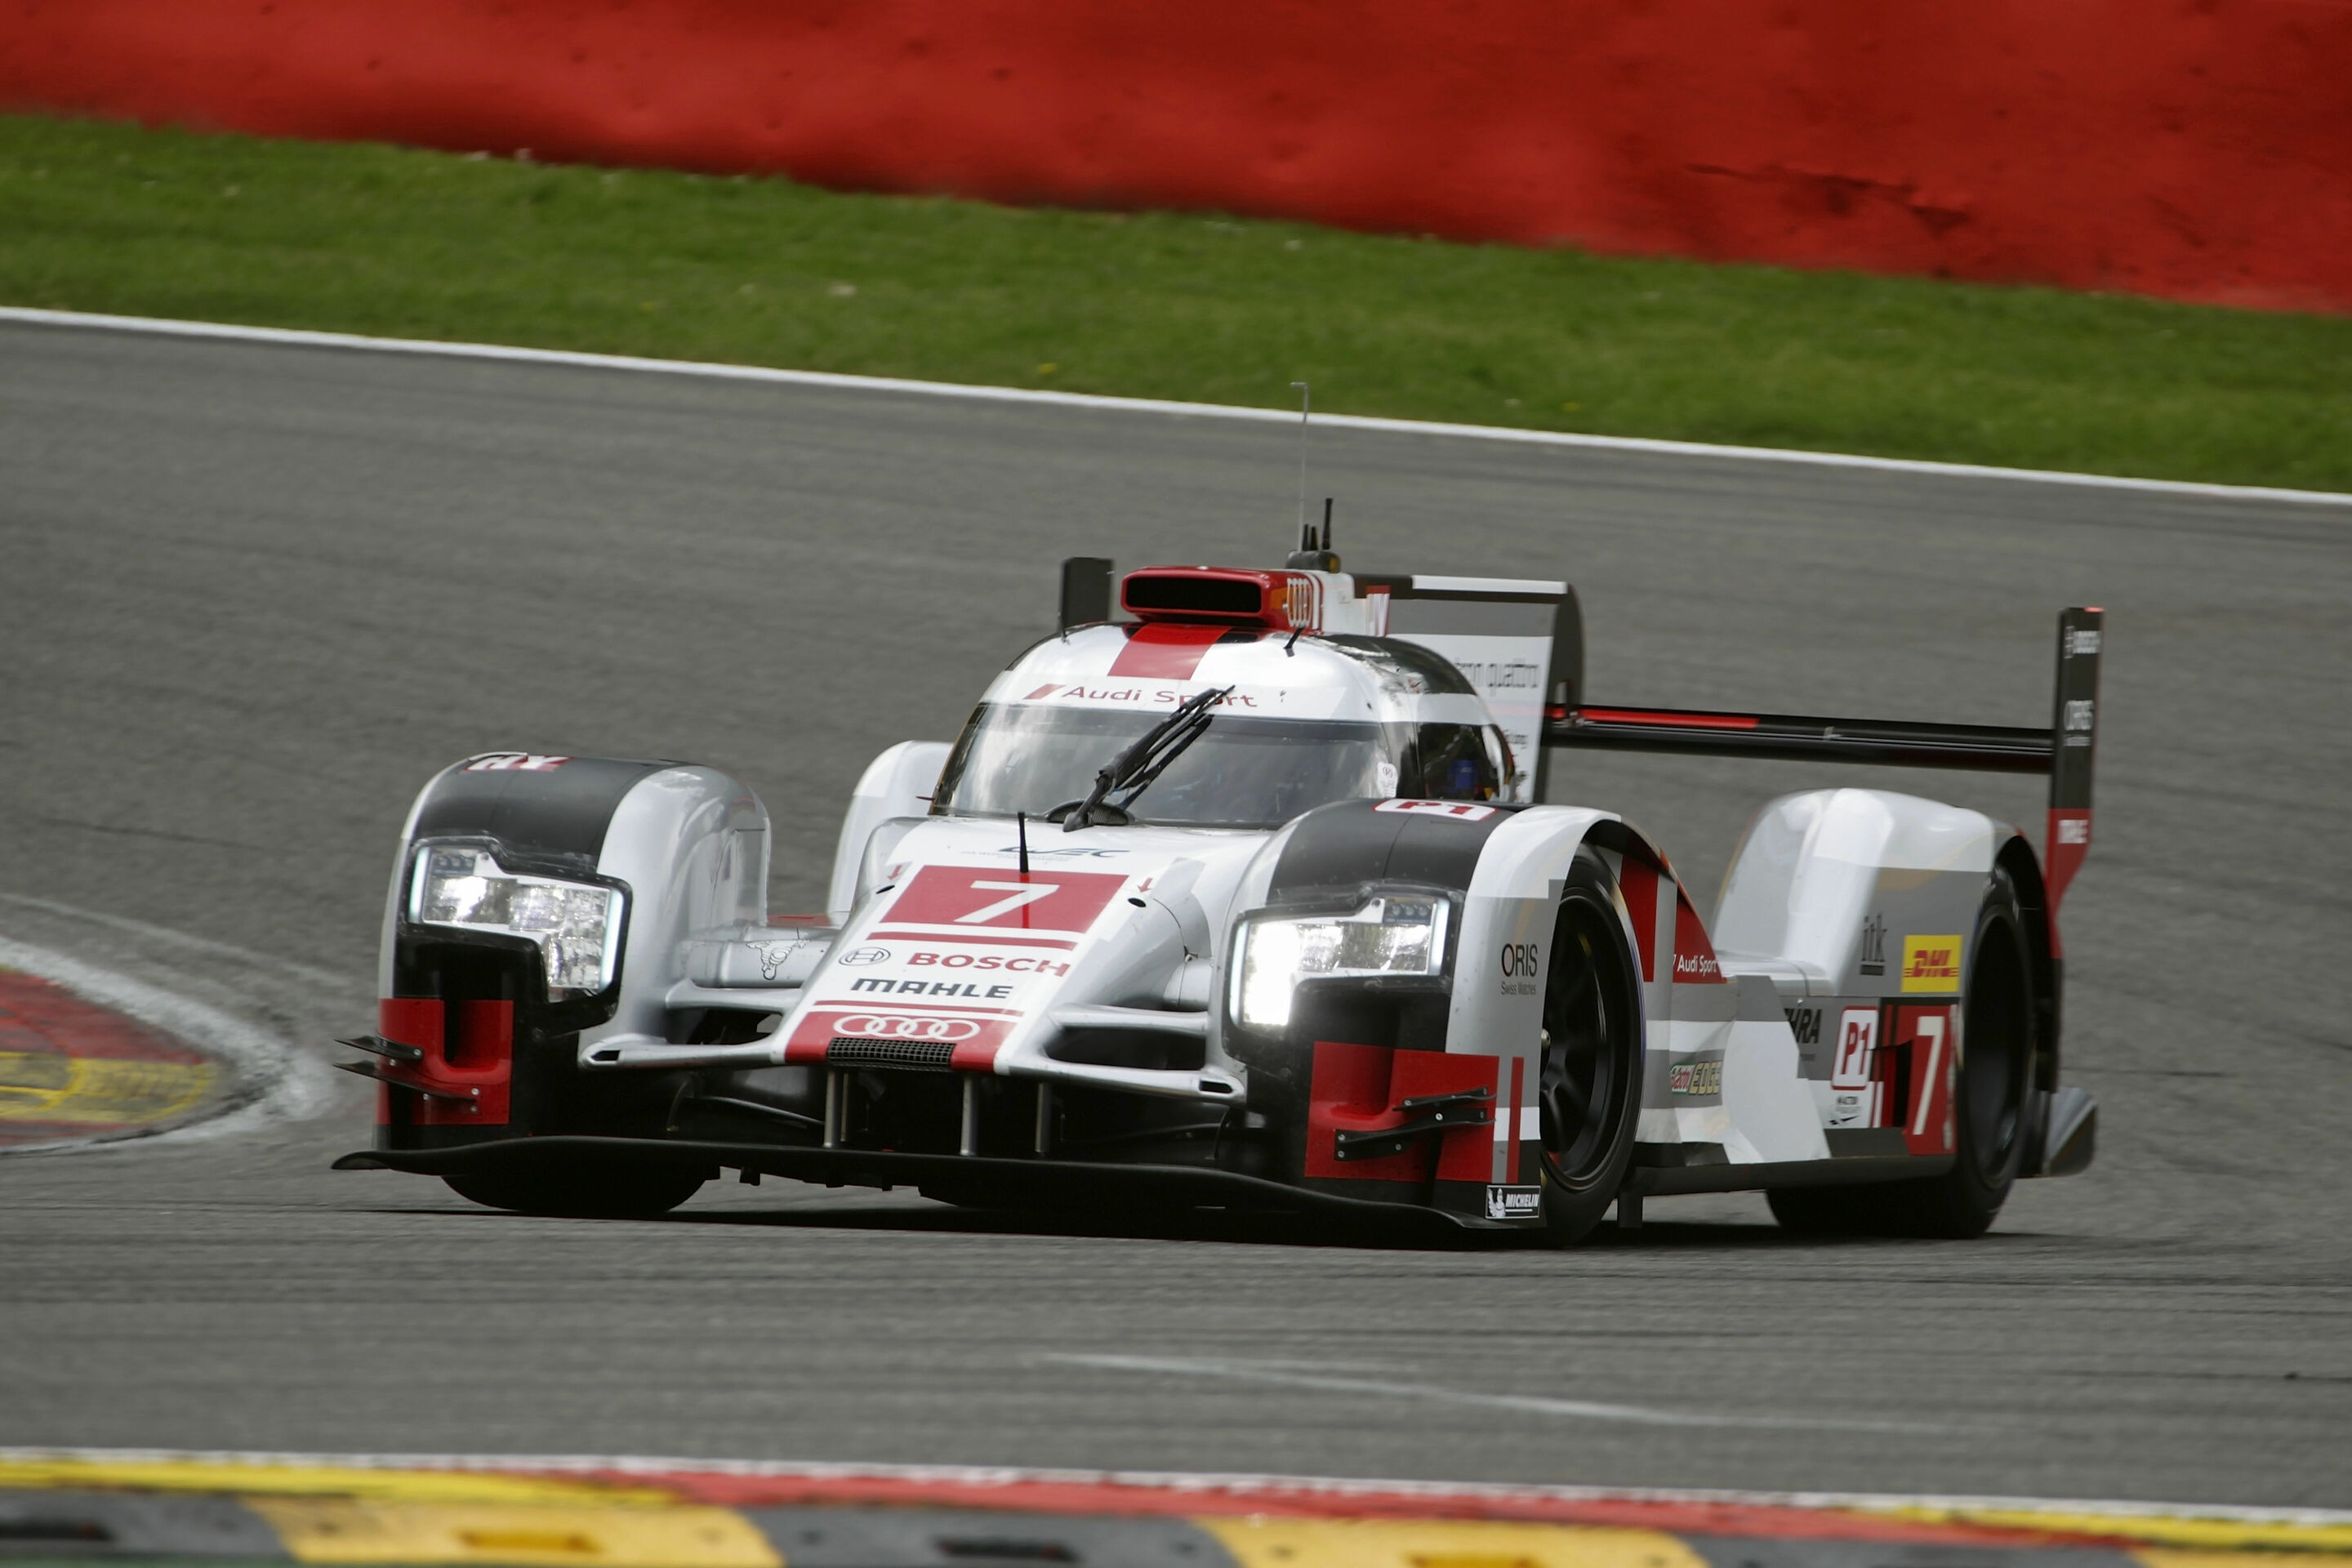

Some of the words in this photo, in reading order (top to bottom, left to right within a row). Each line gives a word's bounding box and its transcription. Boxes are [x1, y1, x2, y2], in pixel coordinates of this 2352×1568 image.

[1061, 686, 1142, 702] Audi
[1396, 800, 1473, 815] P1
[952, 880, 1060, 924] 7
[906, 952, 1071, 978] BOSCH
[1502, 943, 1538, 978] ORIS
[1677, 954, 1699, 973] Audi
[1699, 955, 1717, 977] Sport
[1912, 949, 1953, 978] DHL
[850, 978, 1014, 999] MAHLE
[1840, 1022, 1870, 1075] P1
[1689, 1062, 1722, 1094] EDGE
[1912, 1016, 1945, 1135] 7
[1505, 1193, 1539, 1207] MICHELIN
